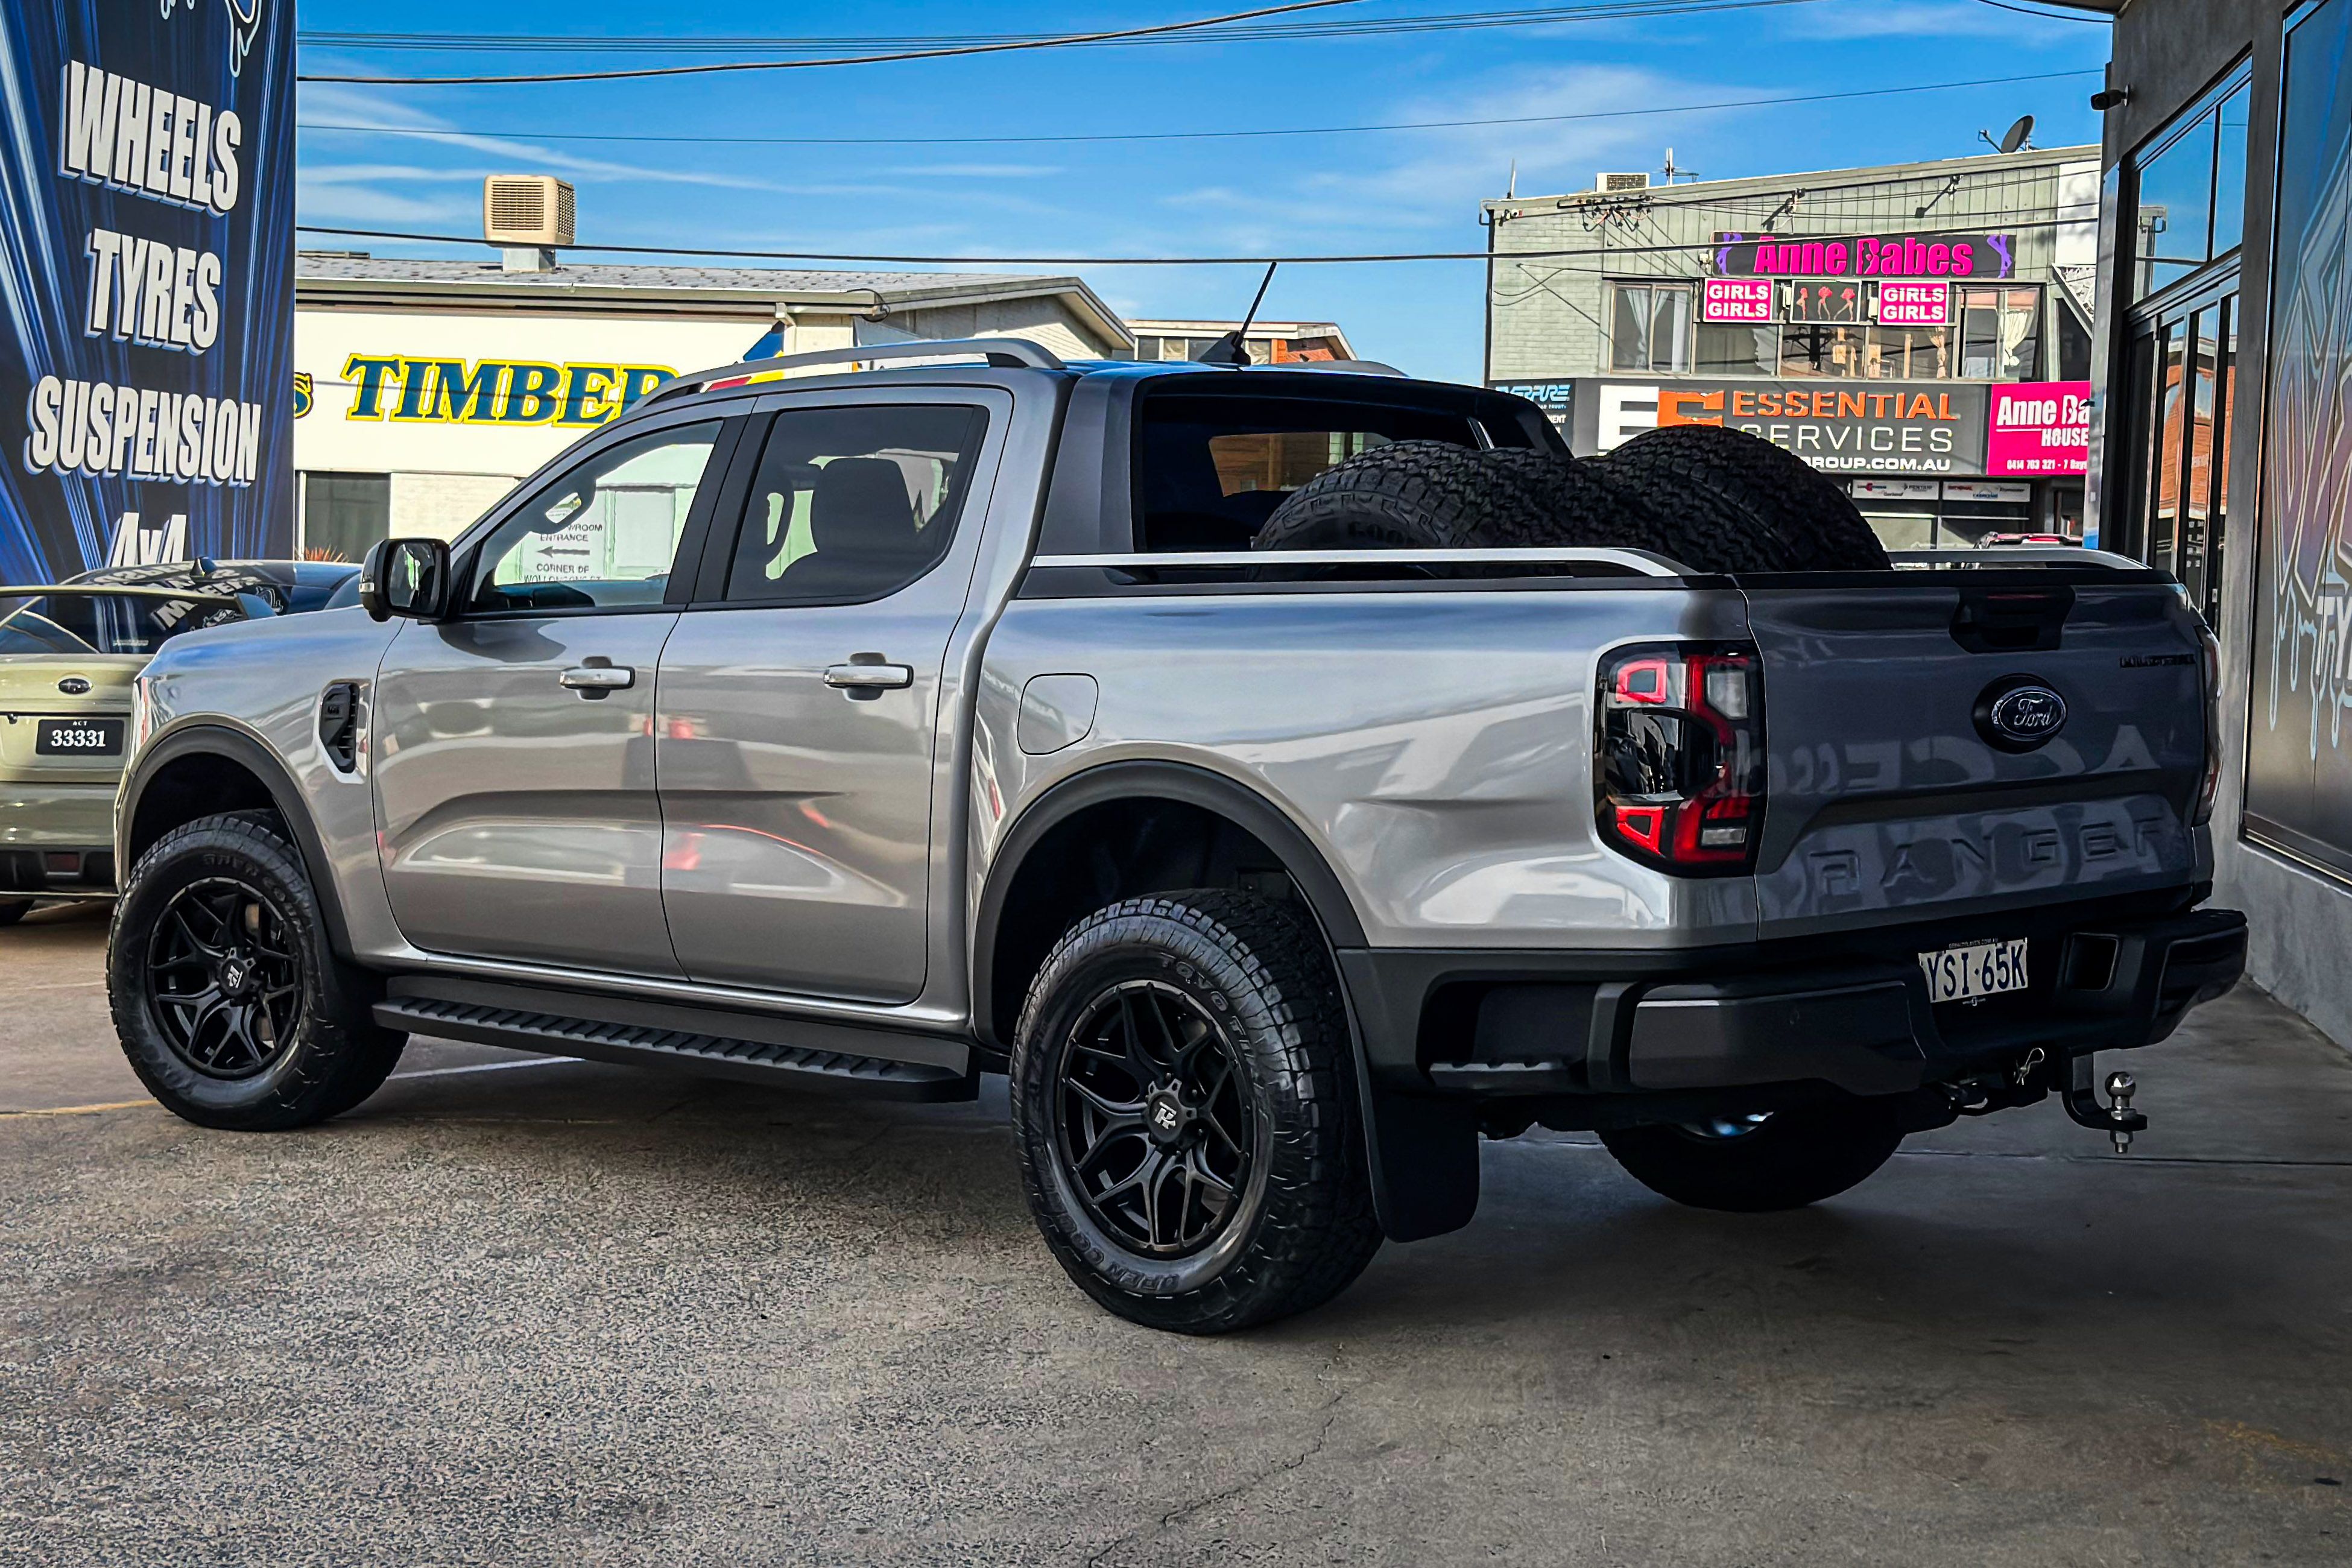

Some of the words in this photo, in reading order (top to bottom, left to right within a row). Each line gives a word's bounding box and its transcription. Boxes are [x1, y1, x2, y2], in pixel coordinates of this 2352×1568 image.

[62, 60, 241, 215] WHEELS
[1753, 236, 1848, 275] Anne
[1856, 237, 1973, 276] Babes
[86, 229, 221, 355] TYRES
[1709, 284, 1769, 300] GIRLS
[1883, 288, 1946, 303] GIRLS
[1707, 302, 1768, 318] GIRLS
[1883, 304, 1944, 320] GIRLS
[1733, 390, 1957, 420] ESSENTIAL
[1997, 396, 2057, 426] Anne
[25, 375, 261, 487] SUSPENSION
[1740, 423, 1952, 453] SERVICES
[2041, 427, 2089, 447] HOUSE
[2042, 459, 2055, 470] 321
[540, 534, 589, 542] ENTRANCE
[537, 563, 575, 574] CORNER
[578, 564, 590, 574] OF
[2014, 698, 2053, 727] Ford
[51, 729, 106, 747] 33331
